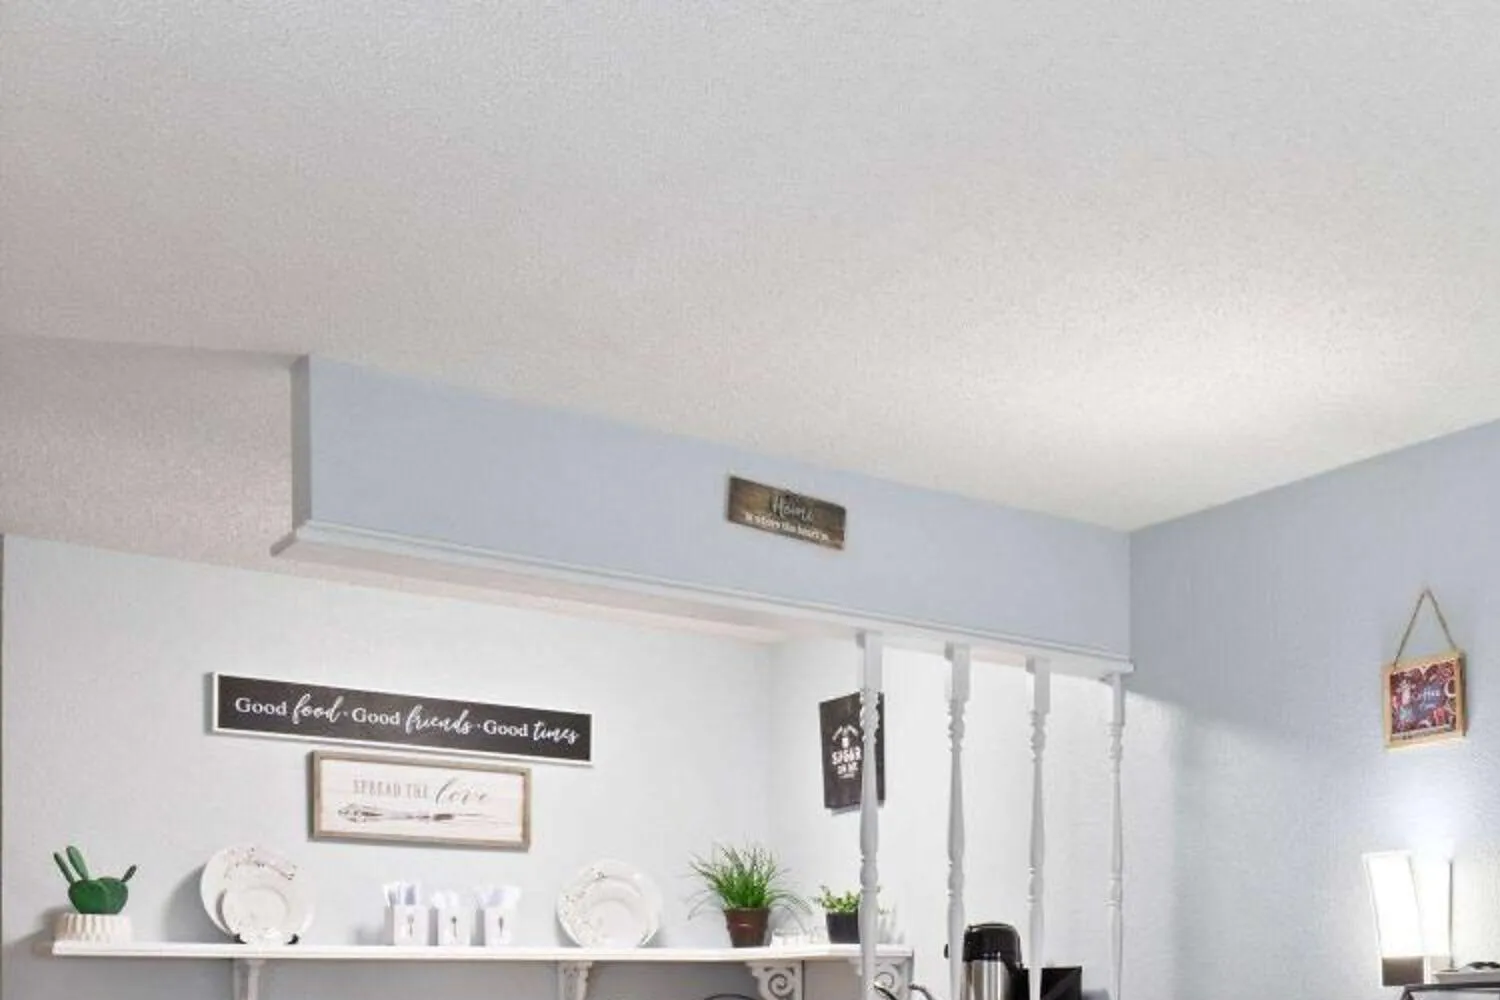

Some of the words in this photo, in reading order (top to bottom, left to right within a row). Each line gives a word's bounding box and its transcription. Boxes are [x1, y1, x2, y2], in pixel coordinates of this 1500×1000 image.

[235, 697, 287, 715] Good
[291, 693, 344, 725] food
[351, 707, 401, 726] Good
[405, 703, 473, 736] friends
[483, 719, 529, 737] Good
[532, 720, 581, 746] times
[352, 779, 402, 798] SPREAD
[406, 783, 429, 799] THE
[434, 777, 488, 806] love
